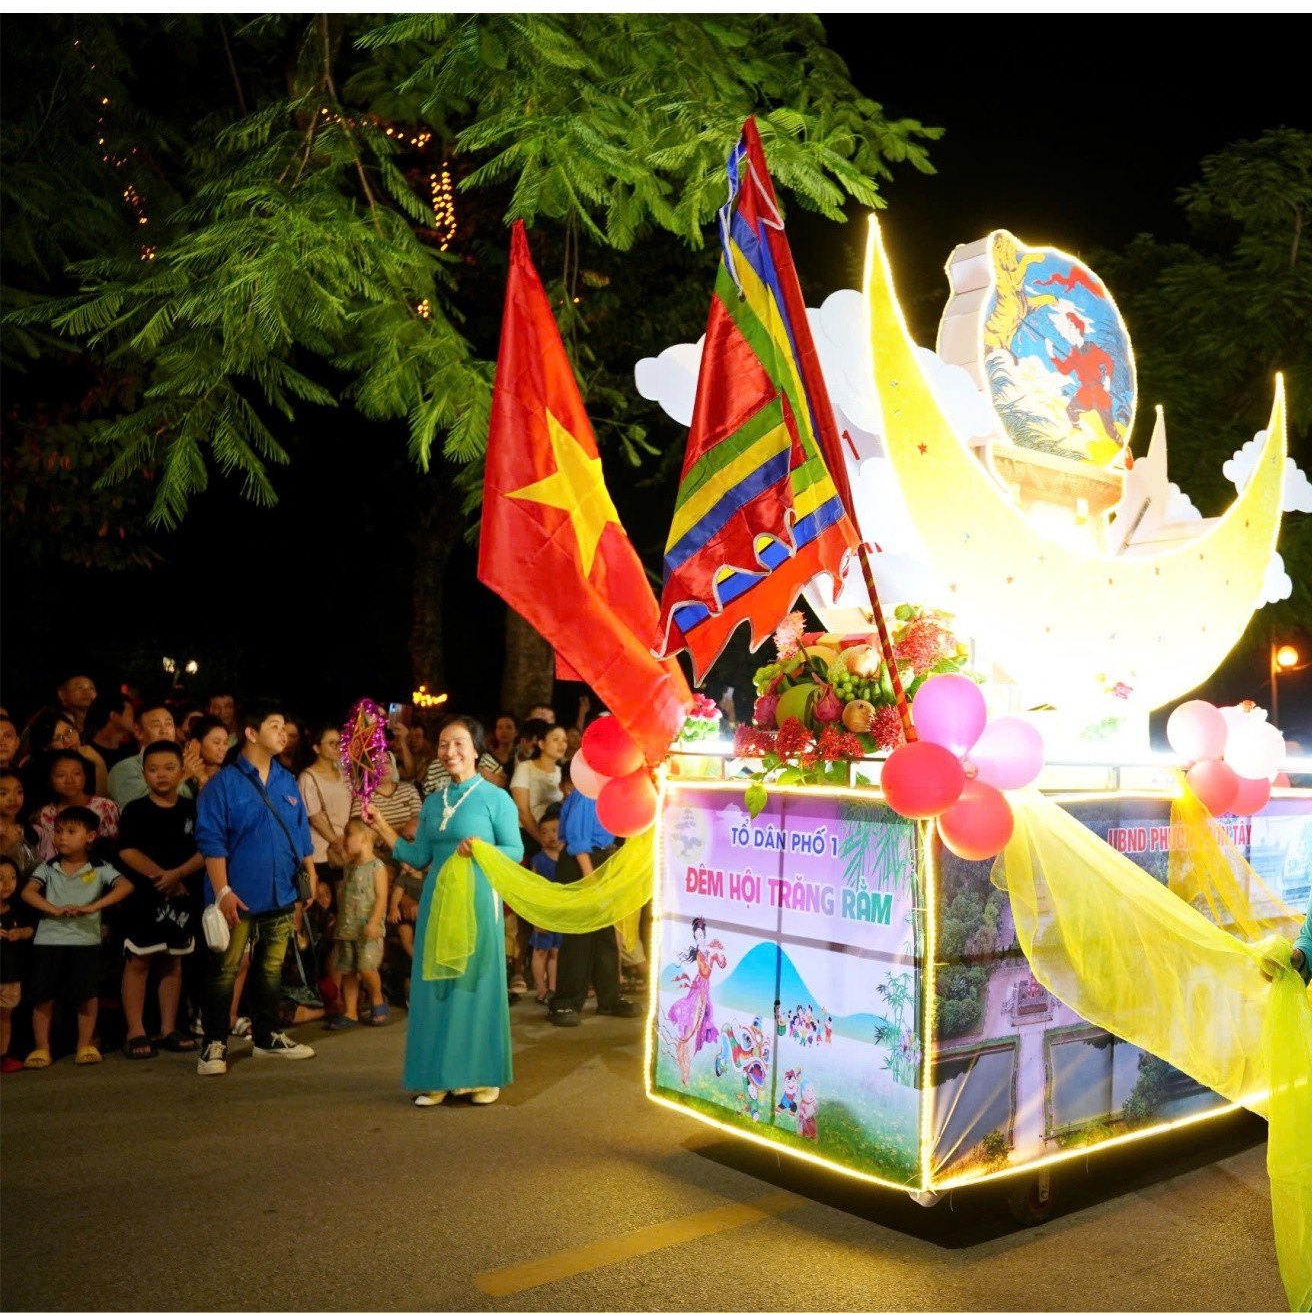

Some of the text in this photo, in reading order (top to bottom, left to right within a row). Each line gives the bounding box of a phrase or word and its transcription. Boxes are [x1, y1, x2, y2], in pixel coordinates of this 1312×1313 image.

[731, 819, 838, 856] TỔ DÂN PHỐ 1
[1108, 827, 1147, 853] UBND
[1233, 821, 1252, 846] TÂY
[685, 863, 893, 925] ĐÊM HỘI TRĂNG RẰM
